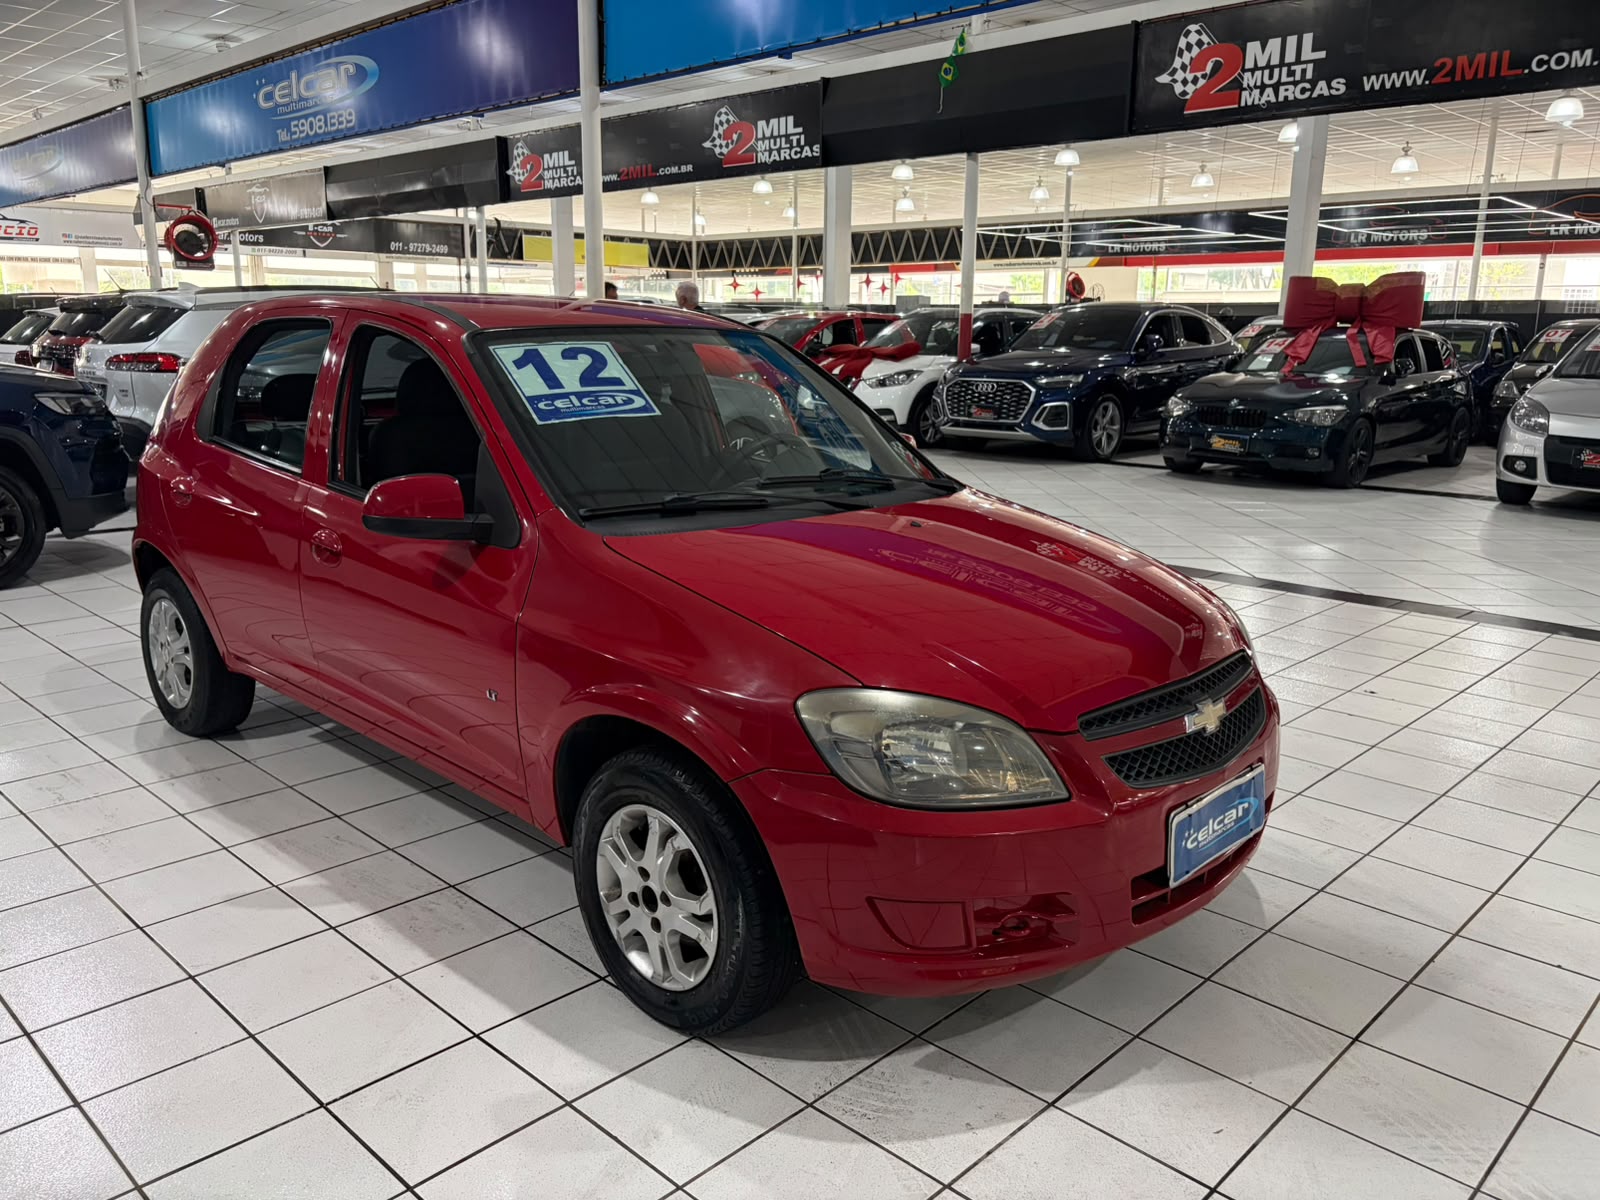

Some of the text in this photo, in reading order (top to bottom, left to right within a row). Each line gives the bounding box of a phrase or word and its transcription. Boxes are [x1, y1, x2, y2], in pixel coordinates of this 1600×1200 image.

[1244, 32, 1327, 70] MIL
[257, 62, 356, 110] celcar
[1184, 42, 1244, 114] 2
[1242, 63, 1314, 88] MULTI
[1240, 78, 1347, 107] MARCAS
[290, 108, 356, 139] 5908.1339
[757, 115, 803, 139] MIL
[722, 121, 756, 168] 2
[757, 134, 805, 152] MULTI
[757, 144, 820, 164] MARCAS
[543, 150, 576, 168] MIL
[520, 154, 544, 192] 2
[543, 166, 577, 180] MULTI
[544, 176, 583, 190] MARCA
[0, 225, 39, 236] CIO
[1350, 229, 1428, 243] LR MOTORS
[1550, 223, 1571, 236] LR
[390, 241, 402, 251] 011
[1123, 241, 1166, 253] MOTORS
[512, 346, 627, 391] 12
[537, 395, 628, 410] celcar
[1186, 802, 1249, 849] celcar
